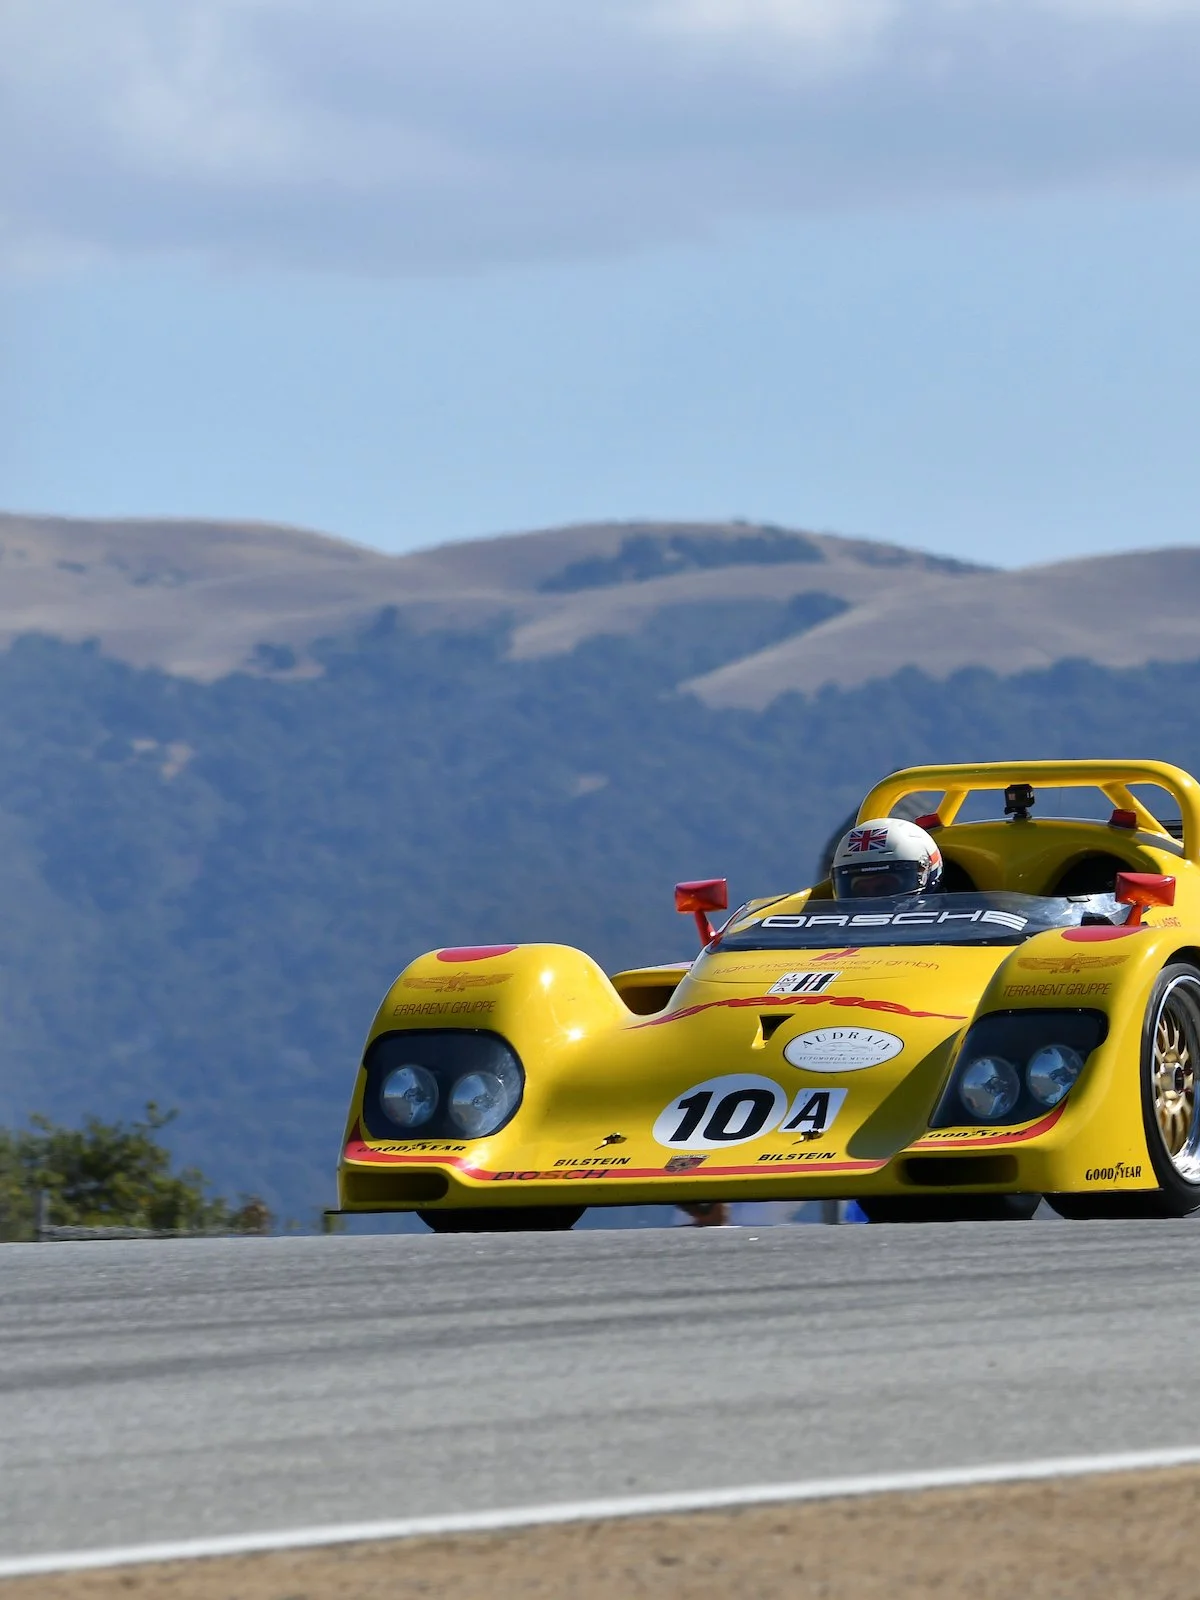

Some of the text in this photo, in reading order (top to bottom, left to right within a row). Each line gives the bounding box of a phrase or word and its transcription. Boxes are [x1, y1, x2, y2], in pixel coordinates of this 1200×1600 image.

[885, 960, 940, 970] gmbh
[1003, 982, 1112, 997] TERRARENT GRUPPE
[451, 1000, 497, 1014] GRUPPE
[802, 1031, 893, 1051] AUDRAIN
[668, 1088, 776, 1142] 10
[784, 1092, 830, 1131] A
[357, 1142, 466, 1153] GOODYEAR
[553, 1157, 631, 1167] BILSTEIN
[758, 1152, 836, 1161] BILSTEIN
[492, 1169, 610, 1181] BOSCH
[1085, 1161, 1142, 1182] GOODYEAR
